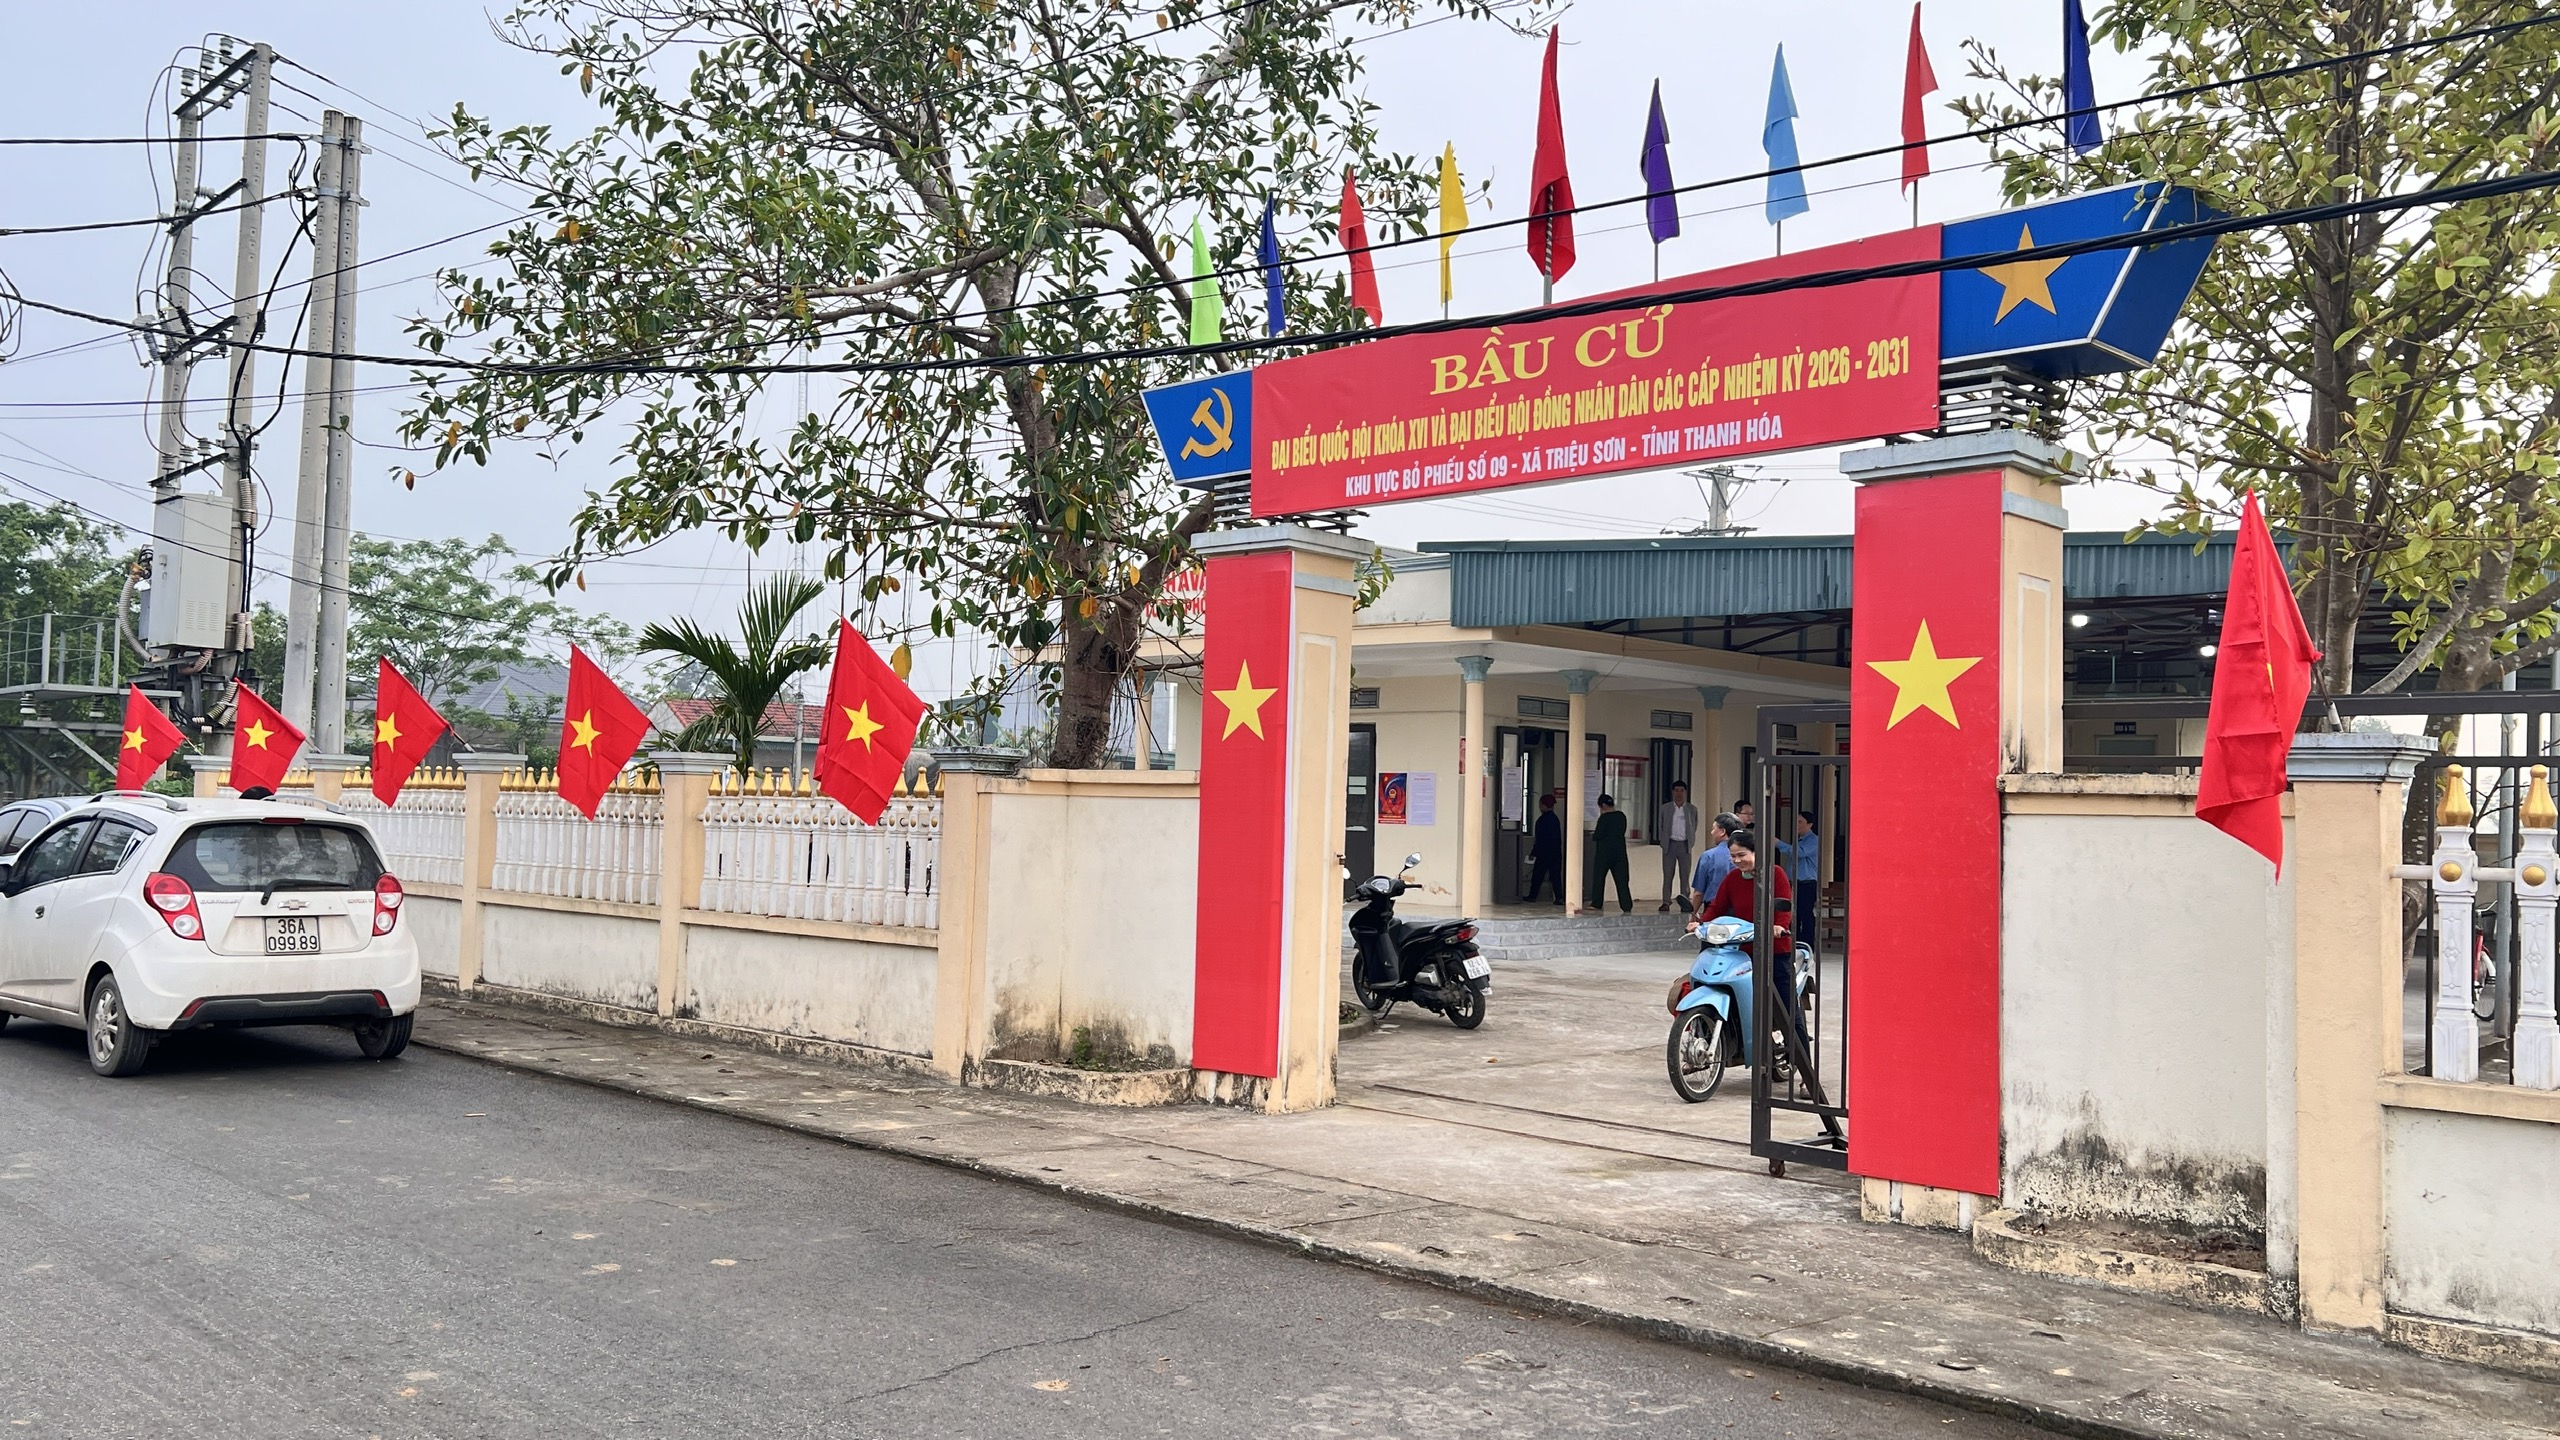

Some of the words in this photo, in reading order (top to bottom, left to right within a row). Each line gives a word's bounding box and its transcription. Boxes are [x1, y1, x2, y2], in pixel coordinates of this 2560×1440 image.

[1430, 326, 1555, 395] BẦU
[1575, 303, 1674, 367] CỨ
[1271, 439, 1290, 475] ĐẠI
[1292, 423, 1317, 468] BIỂU
[1319, 420, 1350, 466] QUỐC
[1351, 420, 1372, 464] HỘI
[1373, 415, 1405, 456] KHÓA
[1407, 416, 1428, 450] XVI
[1431, 407, 1447, 447] VÀ
[1449, 409, 1472, 450] ĐẠI
[1474, 391, 1504, 440] BIỂU
[1507, 393, 1530, 441] HỘI
[1533, 384, 1572, 432] ĐỒNG
[1574, 380, 1615, 425] NHÂN
[1618, 374, 1650, 418] DÂN
[1652, 368, 1684, 413] CÁC
[1688, 355, 1720, 407] CẤP
[1723, 352, 1778, 406] NHIỆM
[1781, 345, 1804, 393] KỲ
[1807, 345, 1850, 389] 2026
[1854, 359, 1863, 370] -
[1866, 335, 1909, 380] 2031
[1345, 474, 1371, 498] KHU
[1374, 469, 1399, 498] VỰC
[1402, 460, 1420, 490] BỎ
[1423, 455, 1464, 488] PHIẾU
[1467, 450, 1487, 482] SỐ
[1489, 455, 1508, 479] 09
[1521, 446, 1541, 474] XÃ
[1545, 439, 1589, 472] TRIỆU
[1592, 436, 1626, 465] SƠN
[1641, 425, 1680, 457] TỈNH
[1684, 420, 1741, 452] THANH
[1746, 411, 1783, 443] HÓA
[267, 935, 319, 951] 099.89
[277, 918, 307, 935] 36A
